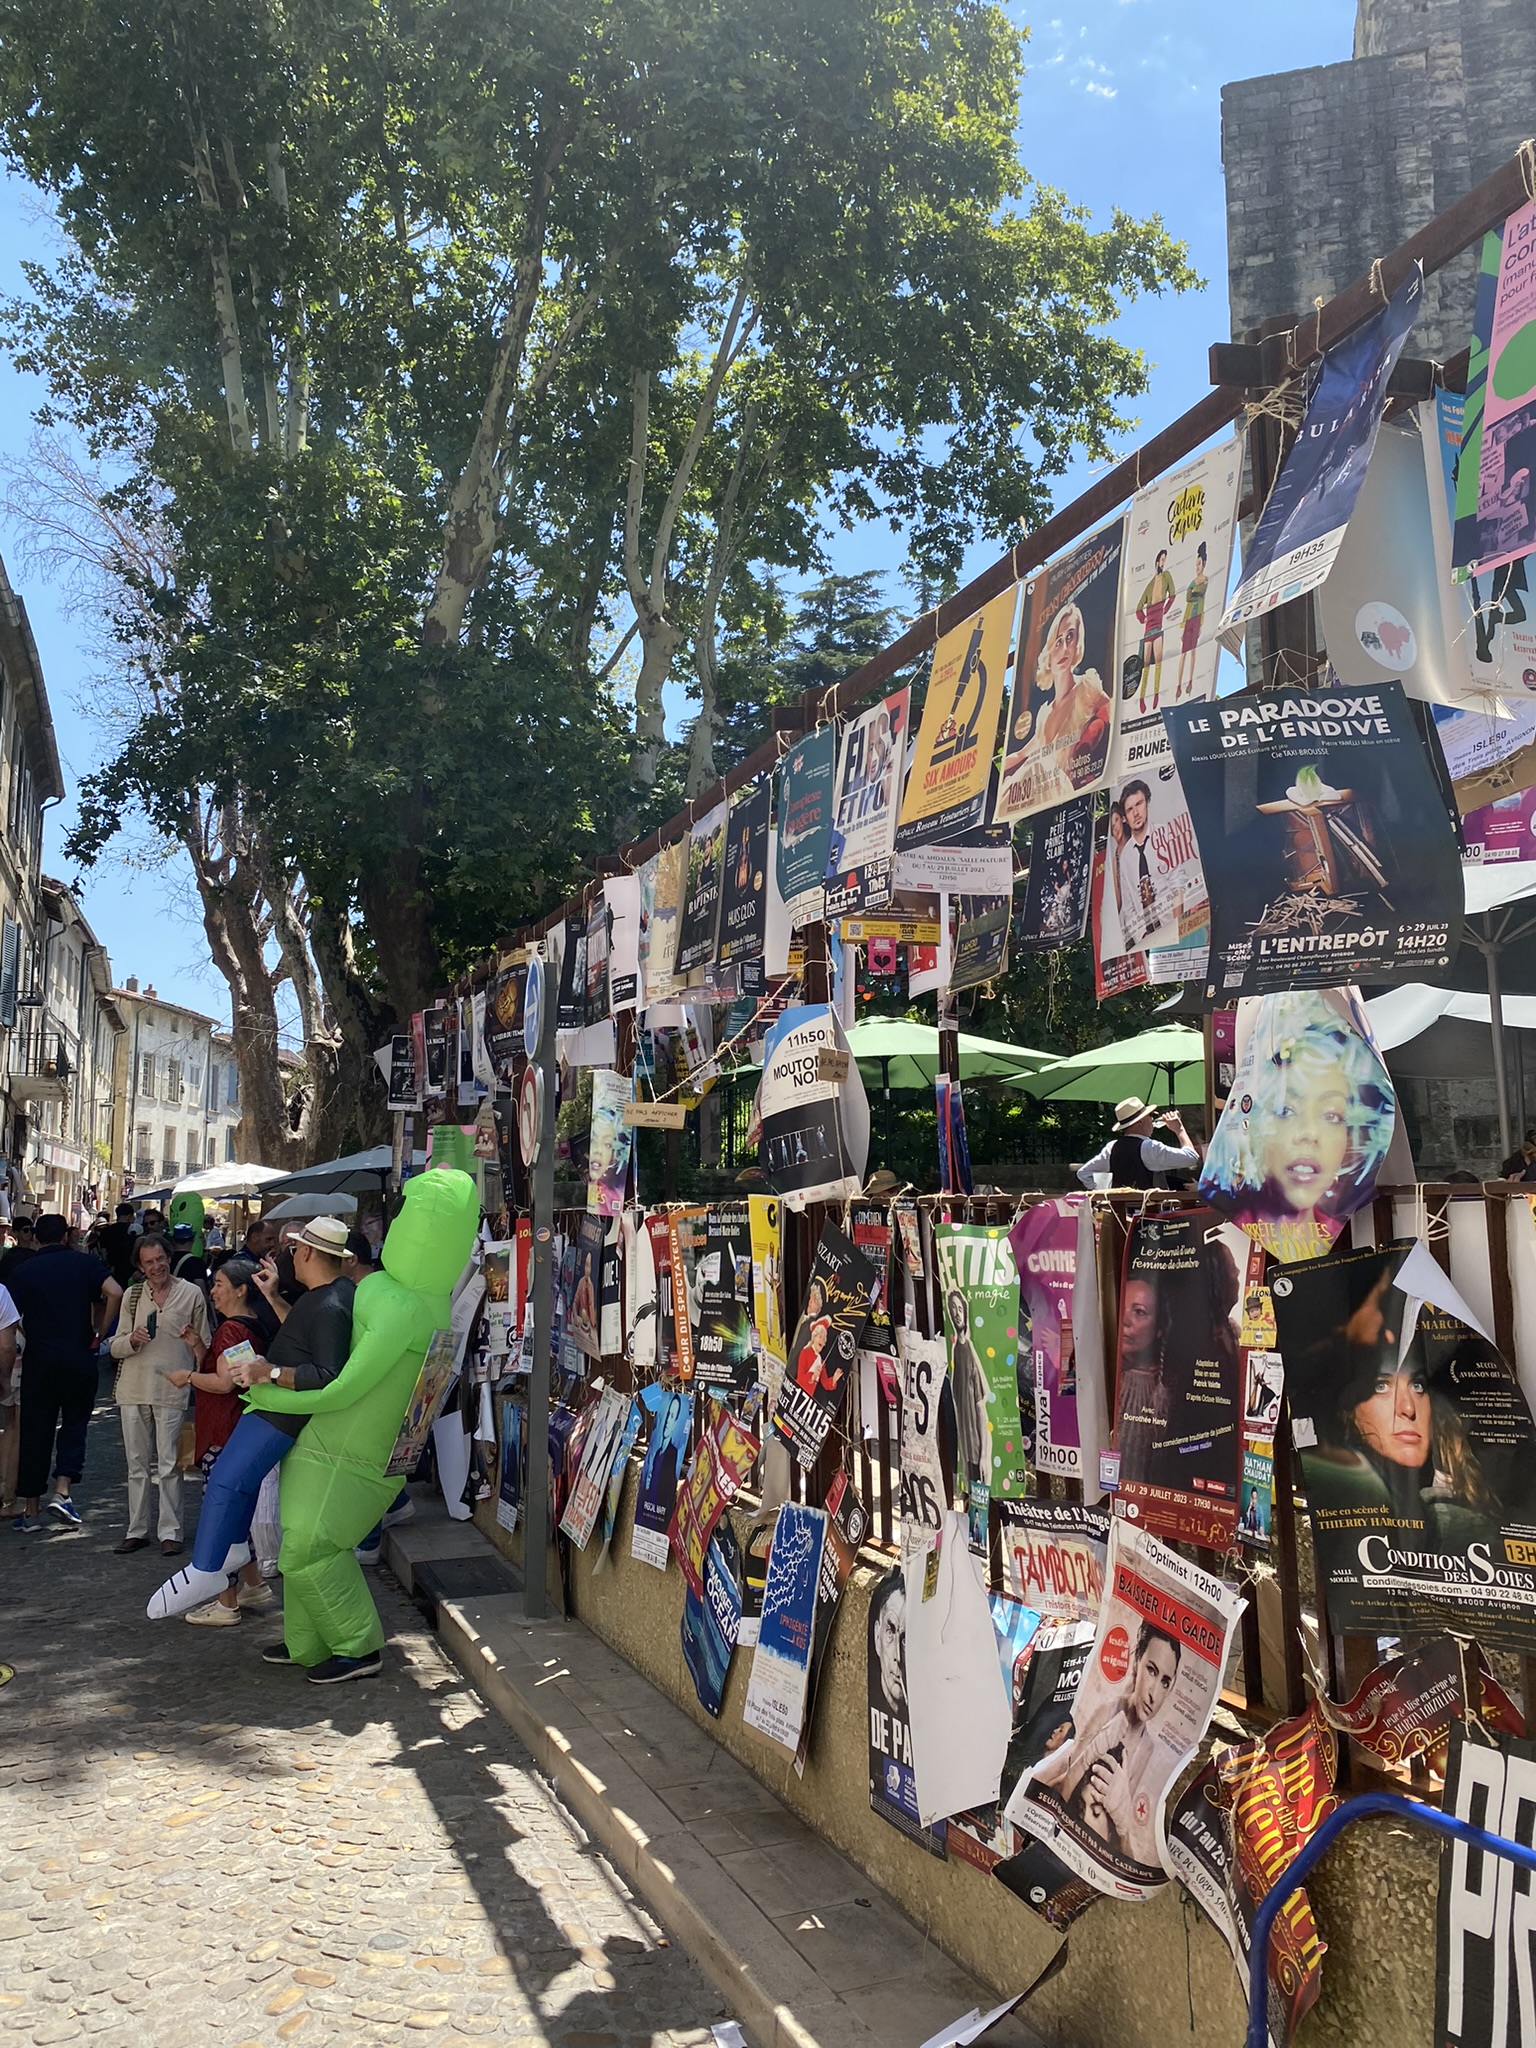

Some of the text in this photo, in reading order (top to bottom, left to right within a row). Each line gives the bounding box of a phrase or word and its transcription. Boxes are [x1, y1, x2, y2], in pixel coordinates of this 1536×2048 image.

[1500, 279, 1526, 307] pour
[1167, 486, 1206, 523] Cadavre
[1169, 507, 1203, 546] exquis
[1290, 540, 1325, 566] 19H35
[1188, 695, 1384, 734] LE PARADOXE
[1220, 718, 1391, 749] DE L'ENDIVE
[1209, 750, 1246, 760] LOUIS-LUCAS
[924, 767, 940, 789] SIX
[940, 749, 977, 782] AMOURS
[1003, 777, 1031, 805] 10h30
[1060, 810, 1066, 822] LE
[1050, 822, 1065, 837] PETIT
[1151, 811, 1190, 851] GRAND
[1045, 833, 1065, 850] PRINCE
[1156, 829, 1199, 876] SOIR
[727, 900, 756, 927] HUIS CLOS
[1398, 924, 1405, 933] 6
[1414, 923, 1425, 932] 29
[1259, 925, 1389, 956] L'ENTREPÔT
[1397, 932, 1448, 949] 14H20
[1296, 953, 1330, 961] Champfleury
[787, 1029, 825, 1048] 11h50
[1308, 1222, 1333, 1240] TES
[1140, 1246, 1153, 1256] Le
[1154, 1247, 1180, 1259] journal
[1132, 1259, 1199, 1270] femme de chambre
[670, 1228, 692, 1373] COUR DU SPECTATEUR
[974, 1290, 1010, 1308] magie
[700, 1335, 723, 1352] 18h50
[1193, 1379, 1221, 1389] Patrick Valette
[1194, 1369, 1204, 1378] Mise
[1186, 1393, 1200, 1402] D'après
[1202, 1394, 1215, 1403] Octave
[791, 1387, 832, 1438] 17H15
[1039, 1396, 1051, 1443] Alya
[1123, 1412, 1167, 1427] Dorothée Hardy
[1141, 1406, 1155, 1415] Avec
[1152, 1440, 1162, 1450] Une
[1163, 1435, 1189, 1448] comédienne
[1039, 1445, 1078, 1465] 19h00
[1244, 1456, 1272, 1472] NATHAN
[1244, 1467, 1272, 1482] CHAUDAT
[1125, 1484, 1211, 1510] AU 29 JUILLET 2023 17H30
[1003, 1501, 1109, 1532] Théâtre de l'Ange
[1316, 1509, 1338, 1518] Mise
[1352, 1506, 1378, 1515] scène
[1380, 1505, 1390, 1514] de
[1318, 1518, 1424, 1530] THIERRY HARCOURT
[1357, 1534, 1466, 1574] CONDITION
[1145, 1541, 1188, 1579] L'Optimist
[1194, 1573, 1221, 1601] 12h00
[1444, 1542, 1535, 1590] DES SOIES
[1366, 1577, 1462, 1595] conditiondessoies.com
[1471, 1587, 1483, 1595] 04
[1485, 1589, 1497, 1597] 90
[1500, 1590, 1511, 1599] 22
[1045, 1600, 1071, 1610] l'histoire
[1119, 1573, 1159, 1616] BAISSER
[1161, 1602, 1177, 1629] LA
[1181, 1617, 1220, 1656] GARDE
[1457, 1597, 1521, 1611] 84000 Avignon
[1102, 1653, 1129, 1669] avignon
[1382, 1673, 1458, 1729] Texte & Mise en scène de
[871, 1706, 889, 1755] DE
[1394, 1714, 1423, 1736] MARTIN
[1275, 1721, 1316, 1801] Une
[1179, 1810, 1217, 1852] du 7 au
[1276, 1805, 1299, 1846] chez
[1182, 1857, 1216, 1898] DES CORPS
